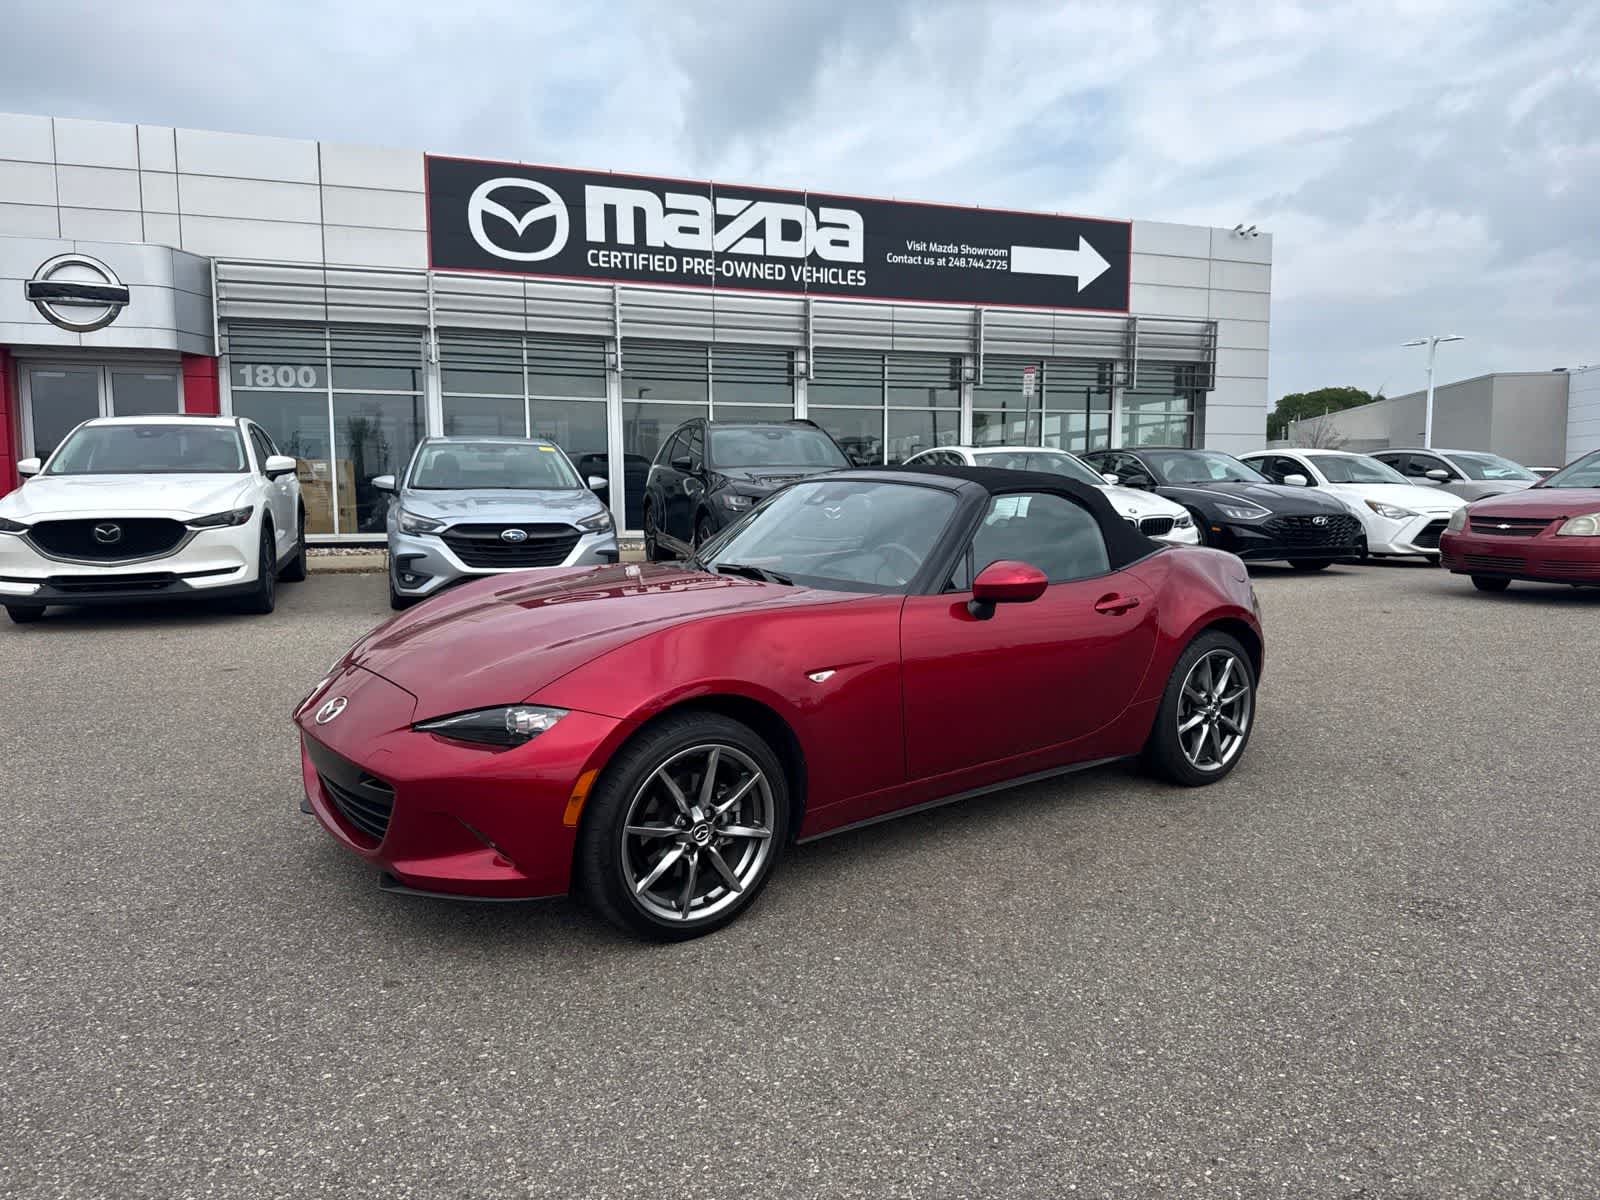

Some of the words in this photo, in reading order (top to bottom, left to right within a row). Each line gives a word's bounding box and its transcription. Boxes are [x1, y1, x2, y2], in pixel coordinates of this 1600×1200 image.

[906, 240, 927, 252] Visit
[928, 242, 959, 254] Mazda
[960, 244, 1008, 256] Showroom
[587, 249, 678, 273] CERTIFIED
[682, 256, 786, 281] PRE-OWNED
[790, 265, 867, 286] VEHICLES
[886, 252, 922, 265] Contact
[923, 256, 935, 266] us
[936, 256, 947, 267] at
[948, 257, 1008, 270] 248.744.2725
[239, 365, 316, 387] 1800
